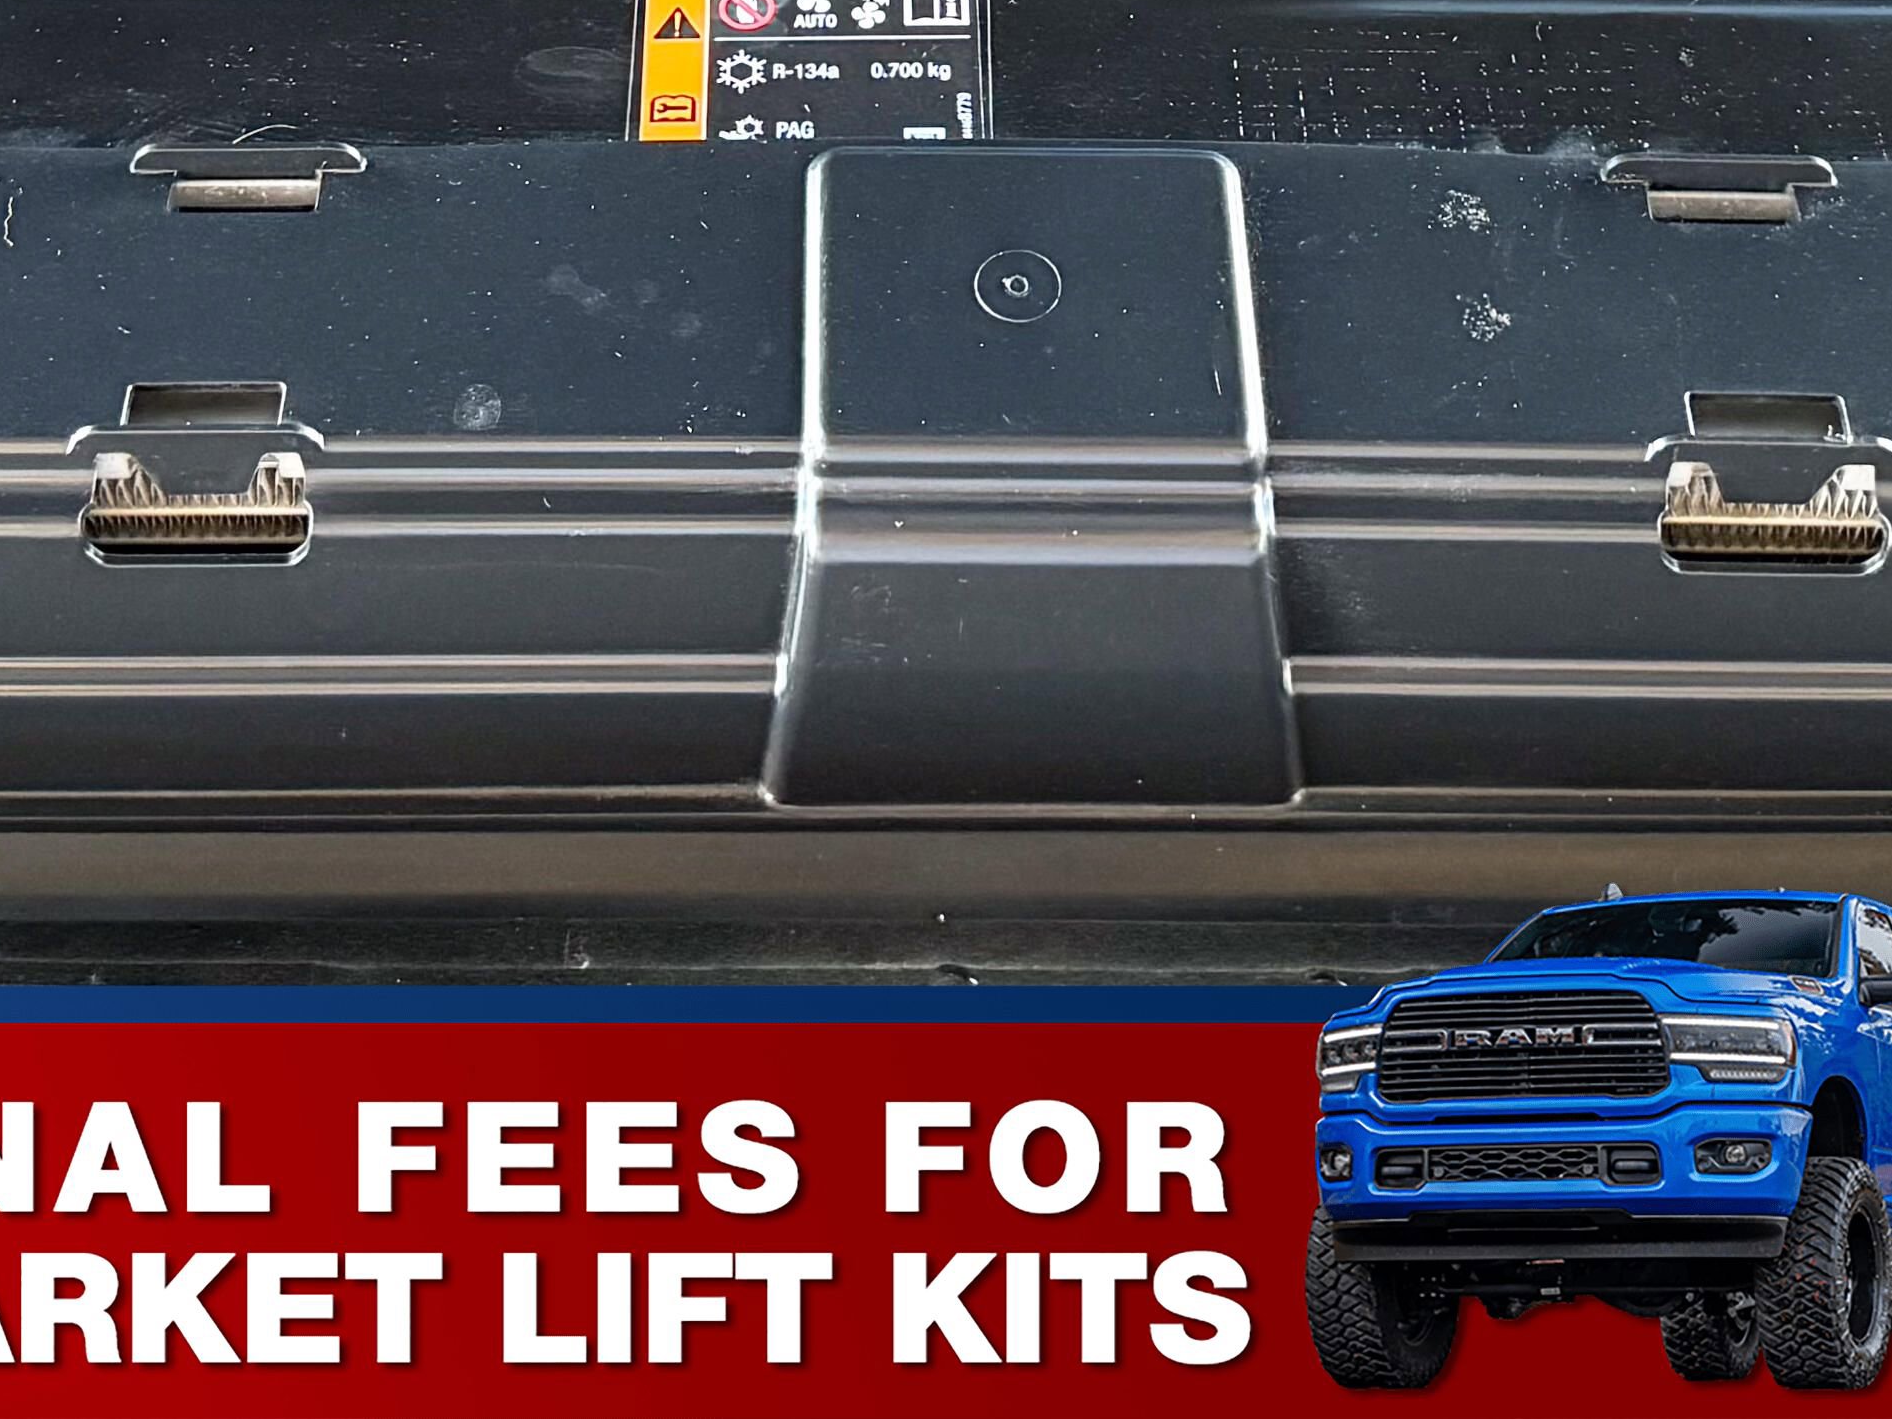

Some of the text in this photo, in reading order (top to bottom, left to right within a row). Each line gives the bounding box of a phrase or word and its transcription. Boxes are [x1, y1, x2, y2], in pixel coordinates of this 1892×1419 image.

[793, 13, 838, 29] AUTO
[772, 62, 952, 81] R-134a 0.700 kg
[775, 120, 815, 140] PAG
